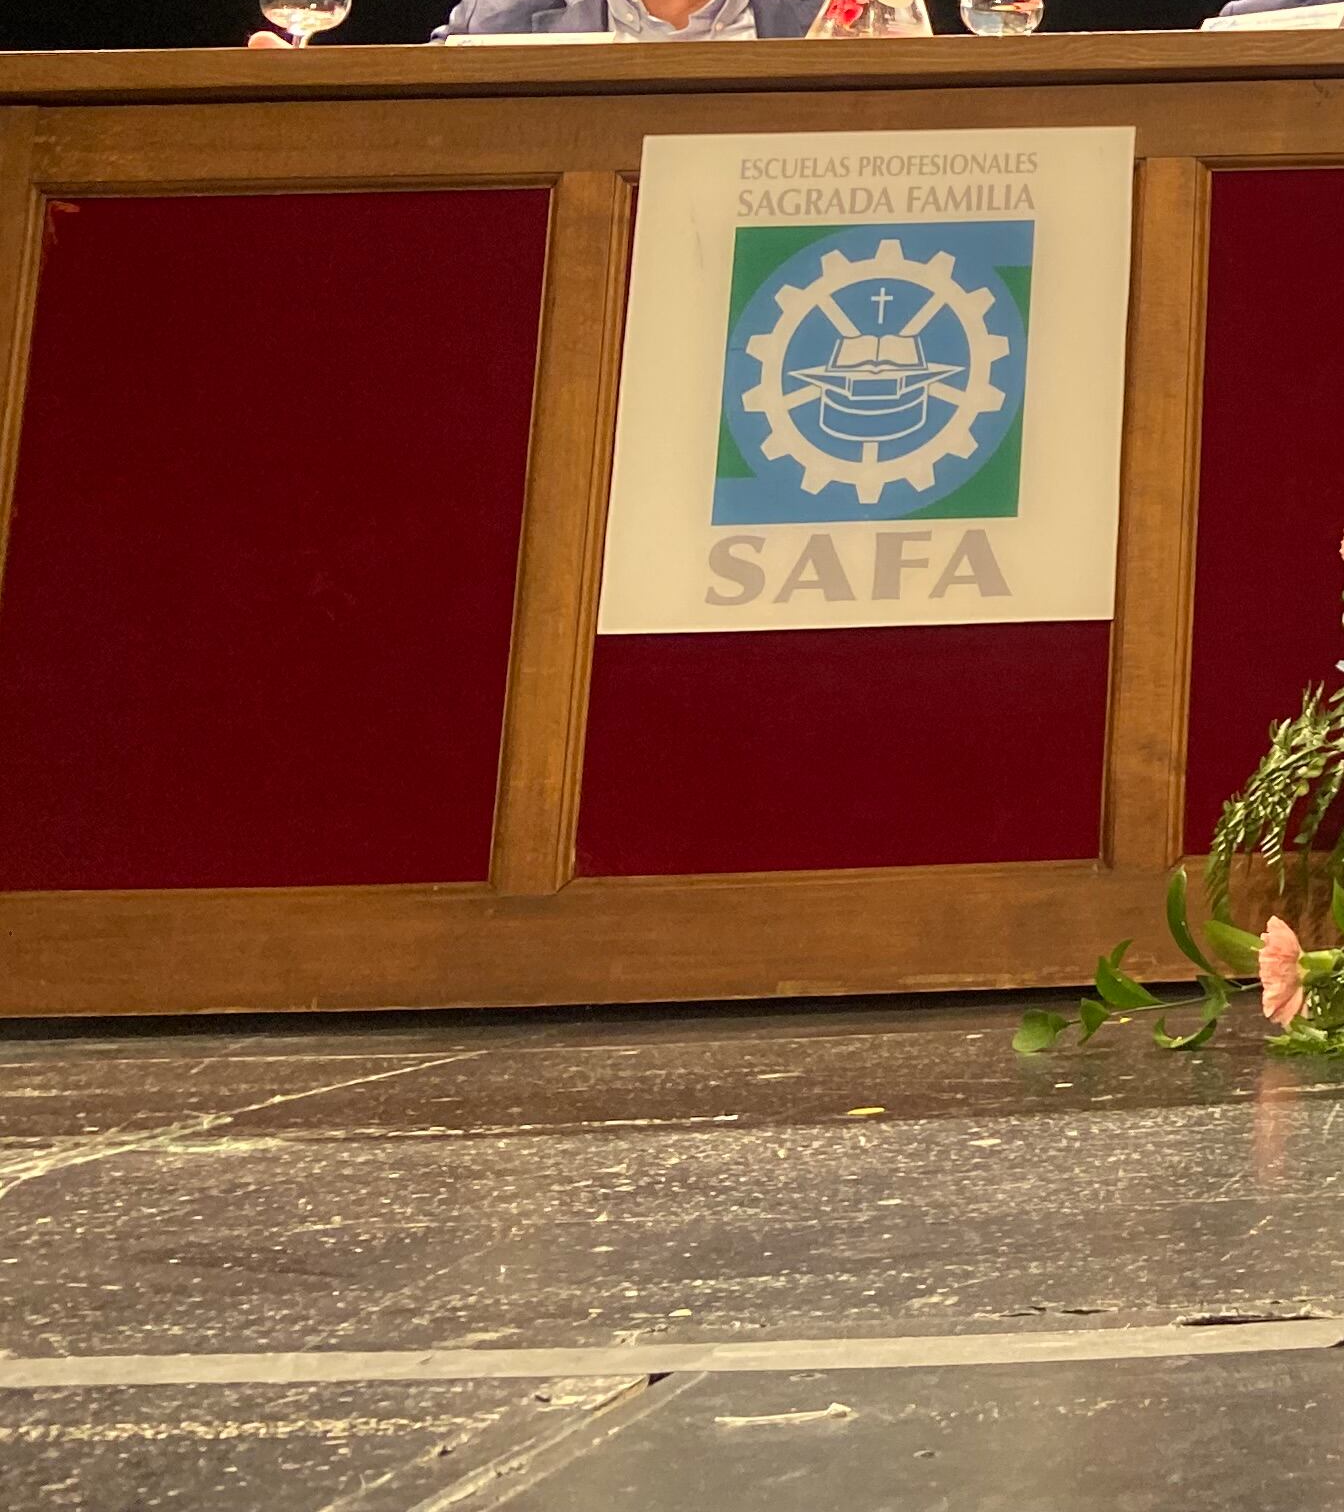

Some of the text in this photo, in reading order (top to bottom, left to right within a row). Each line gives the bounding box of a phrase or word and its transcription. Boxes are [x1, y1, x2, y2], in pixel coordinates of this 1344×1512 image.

[739, 151, 1039, 180] ESCUELAS PROFESIONALES
[737, 183, 1036, 217] SAGRADA FAMILIA
[704, 529, 1013, 607] SAFA
